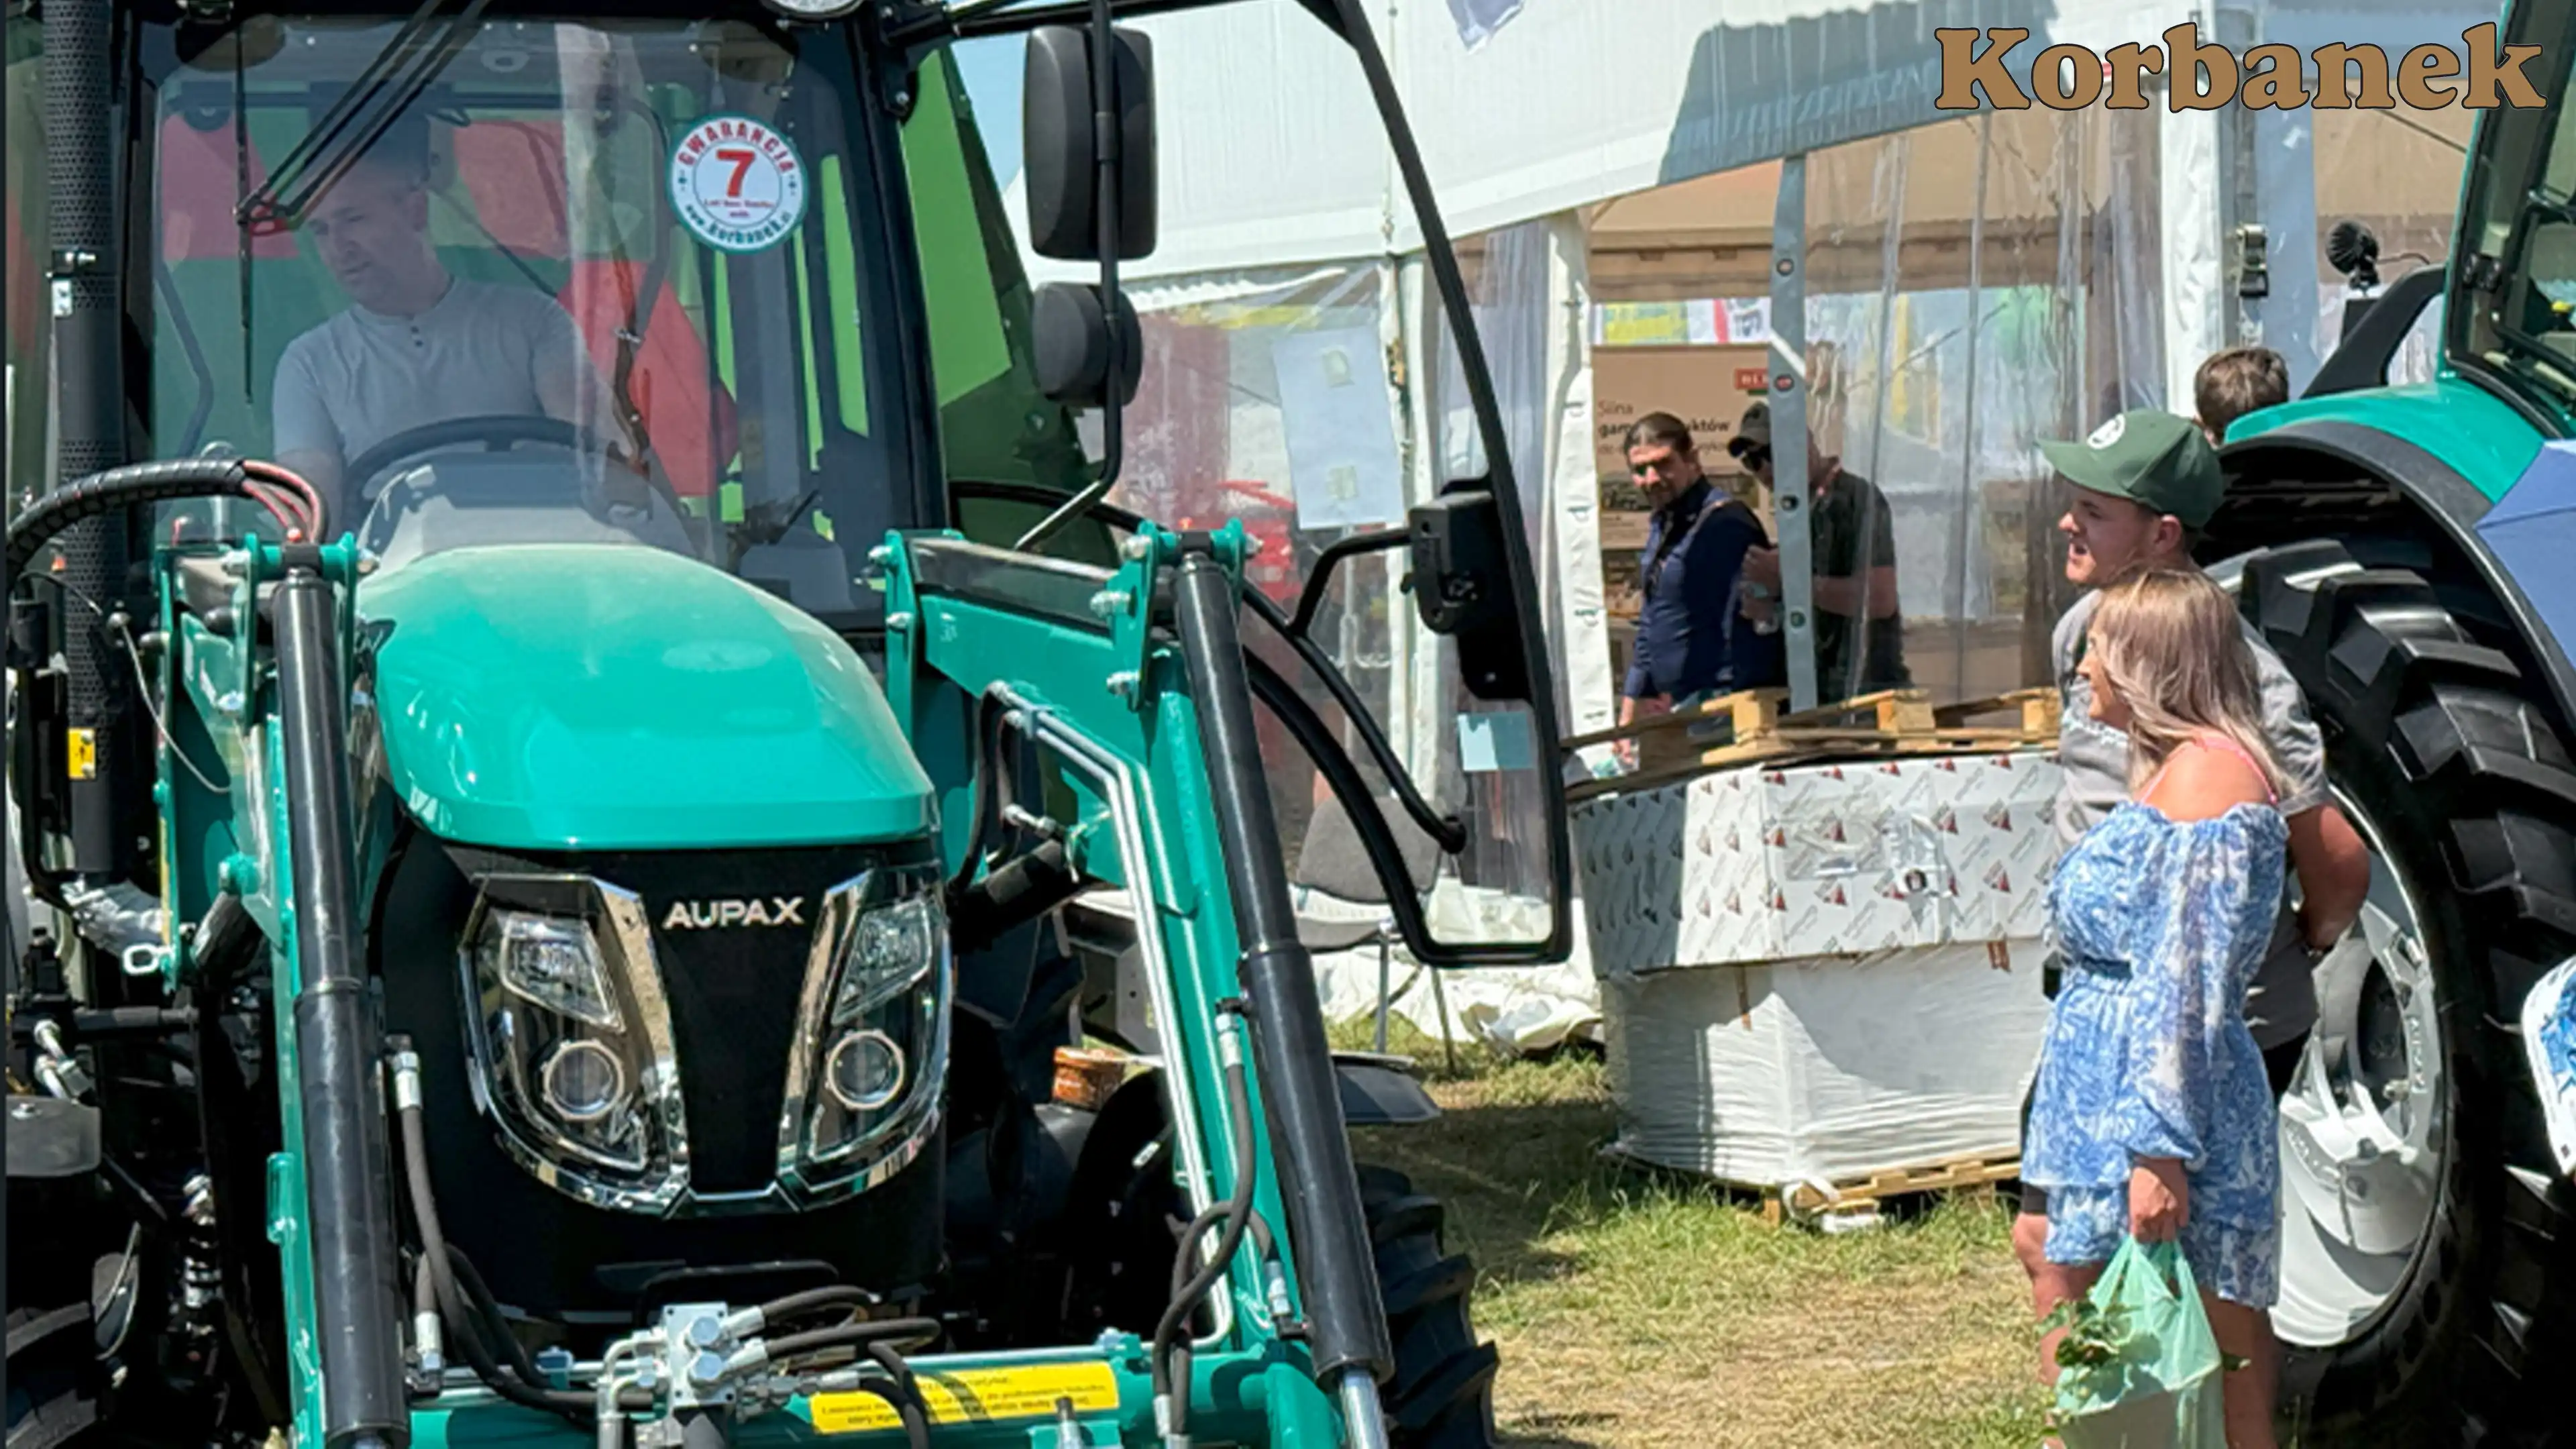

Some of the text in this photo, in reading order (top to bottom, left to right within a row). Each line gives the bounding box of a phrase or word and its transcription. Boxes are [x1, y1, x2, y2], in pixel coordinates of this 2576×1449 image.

[678, 120, 796, 172] GWARANCJA
[716, 148, 756, 198] 7
[661, 896, 805, 930] AUPAX
